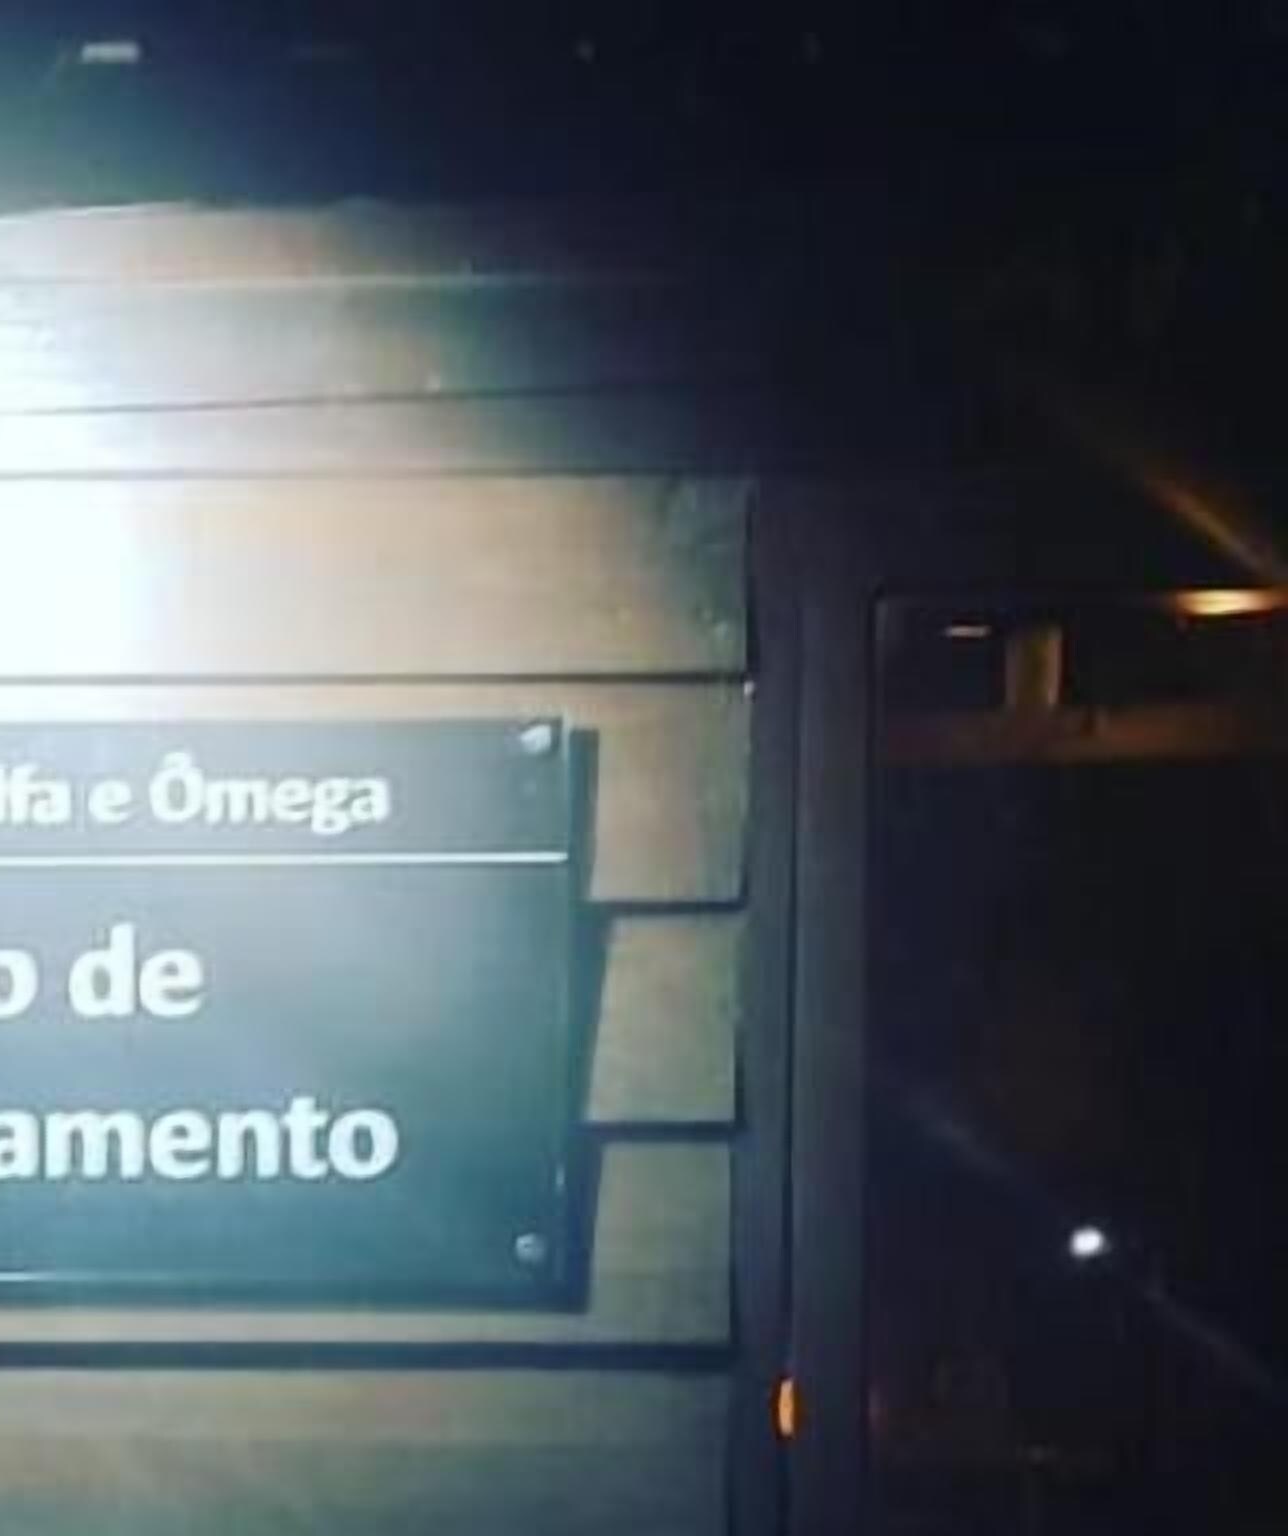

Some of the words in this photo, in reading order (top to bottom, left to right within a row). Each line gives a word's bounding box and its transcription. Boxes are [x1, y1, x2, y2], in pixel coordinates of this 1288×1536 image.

[88, 780, 132, 823] e
[149, 752, 390, 835] Ômega
[68, 922, 203, 1017] de
